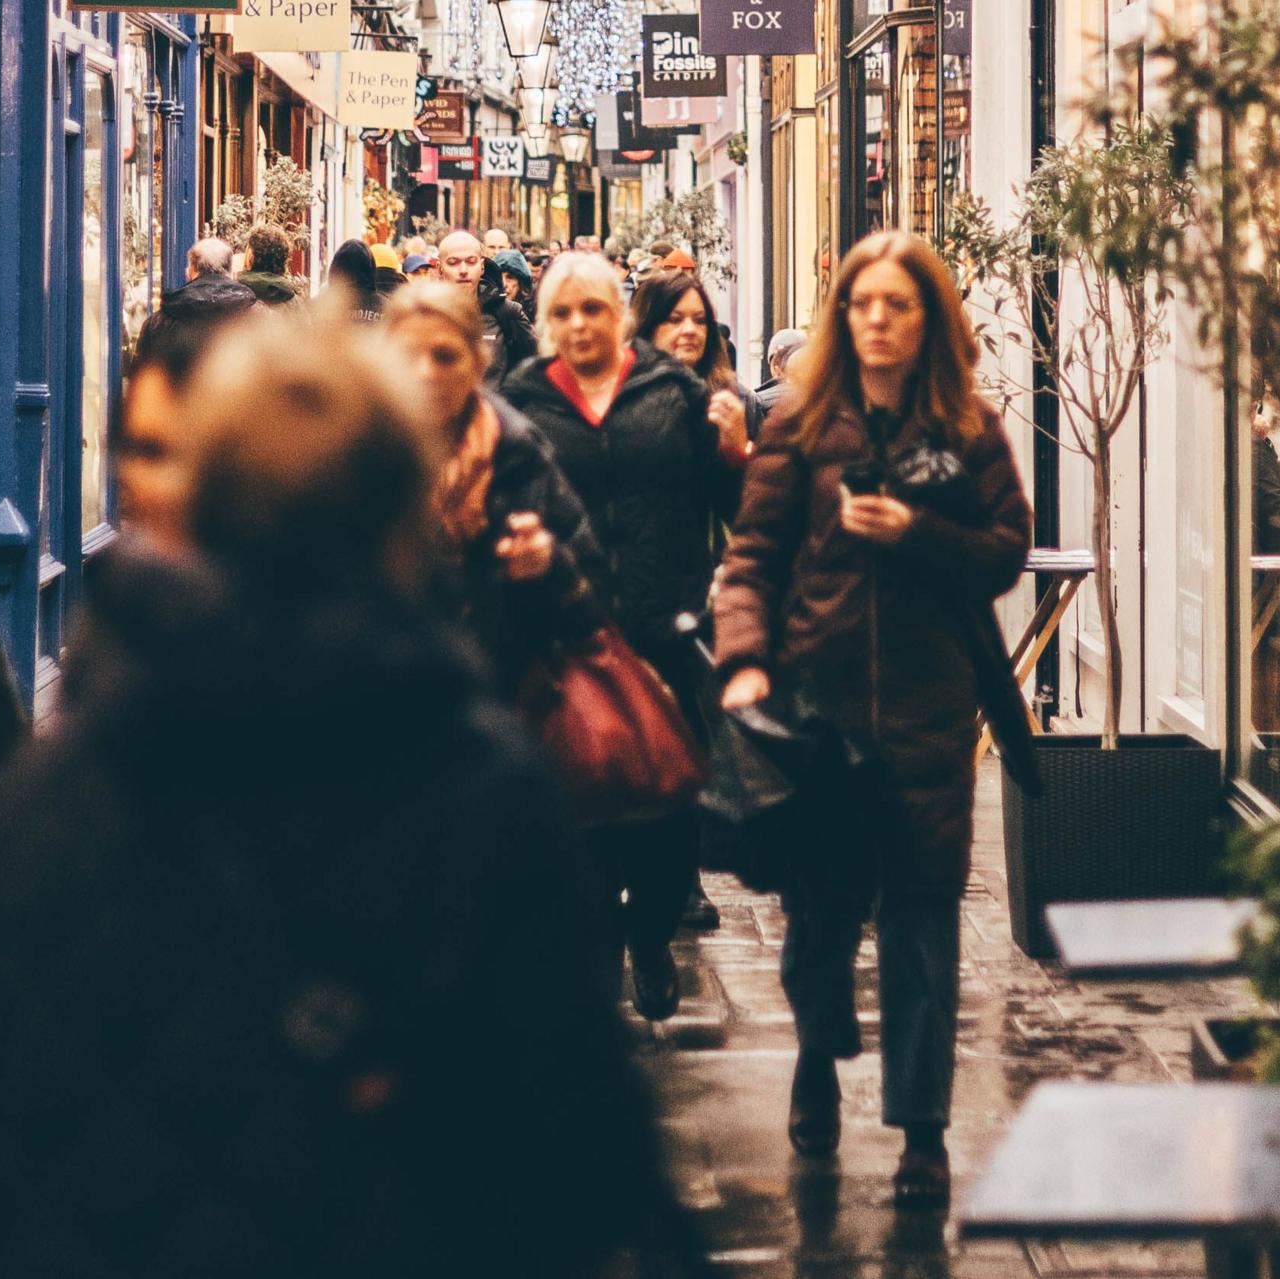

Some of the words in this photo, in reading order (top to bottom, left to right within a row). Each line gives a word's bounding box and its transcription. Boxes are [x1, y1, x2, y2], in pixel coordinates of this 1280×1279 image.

[732, 11, 782, 29] FOX
[652, 55, 717, 71] Fossils
[348, 71, 377, 87] The
[380, 71, 409, 88] Pen
[652, 72, 717, 82] CARDIFF
[345, 92, 357, 105] &
[361, 92, 407, 109] Paper
